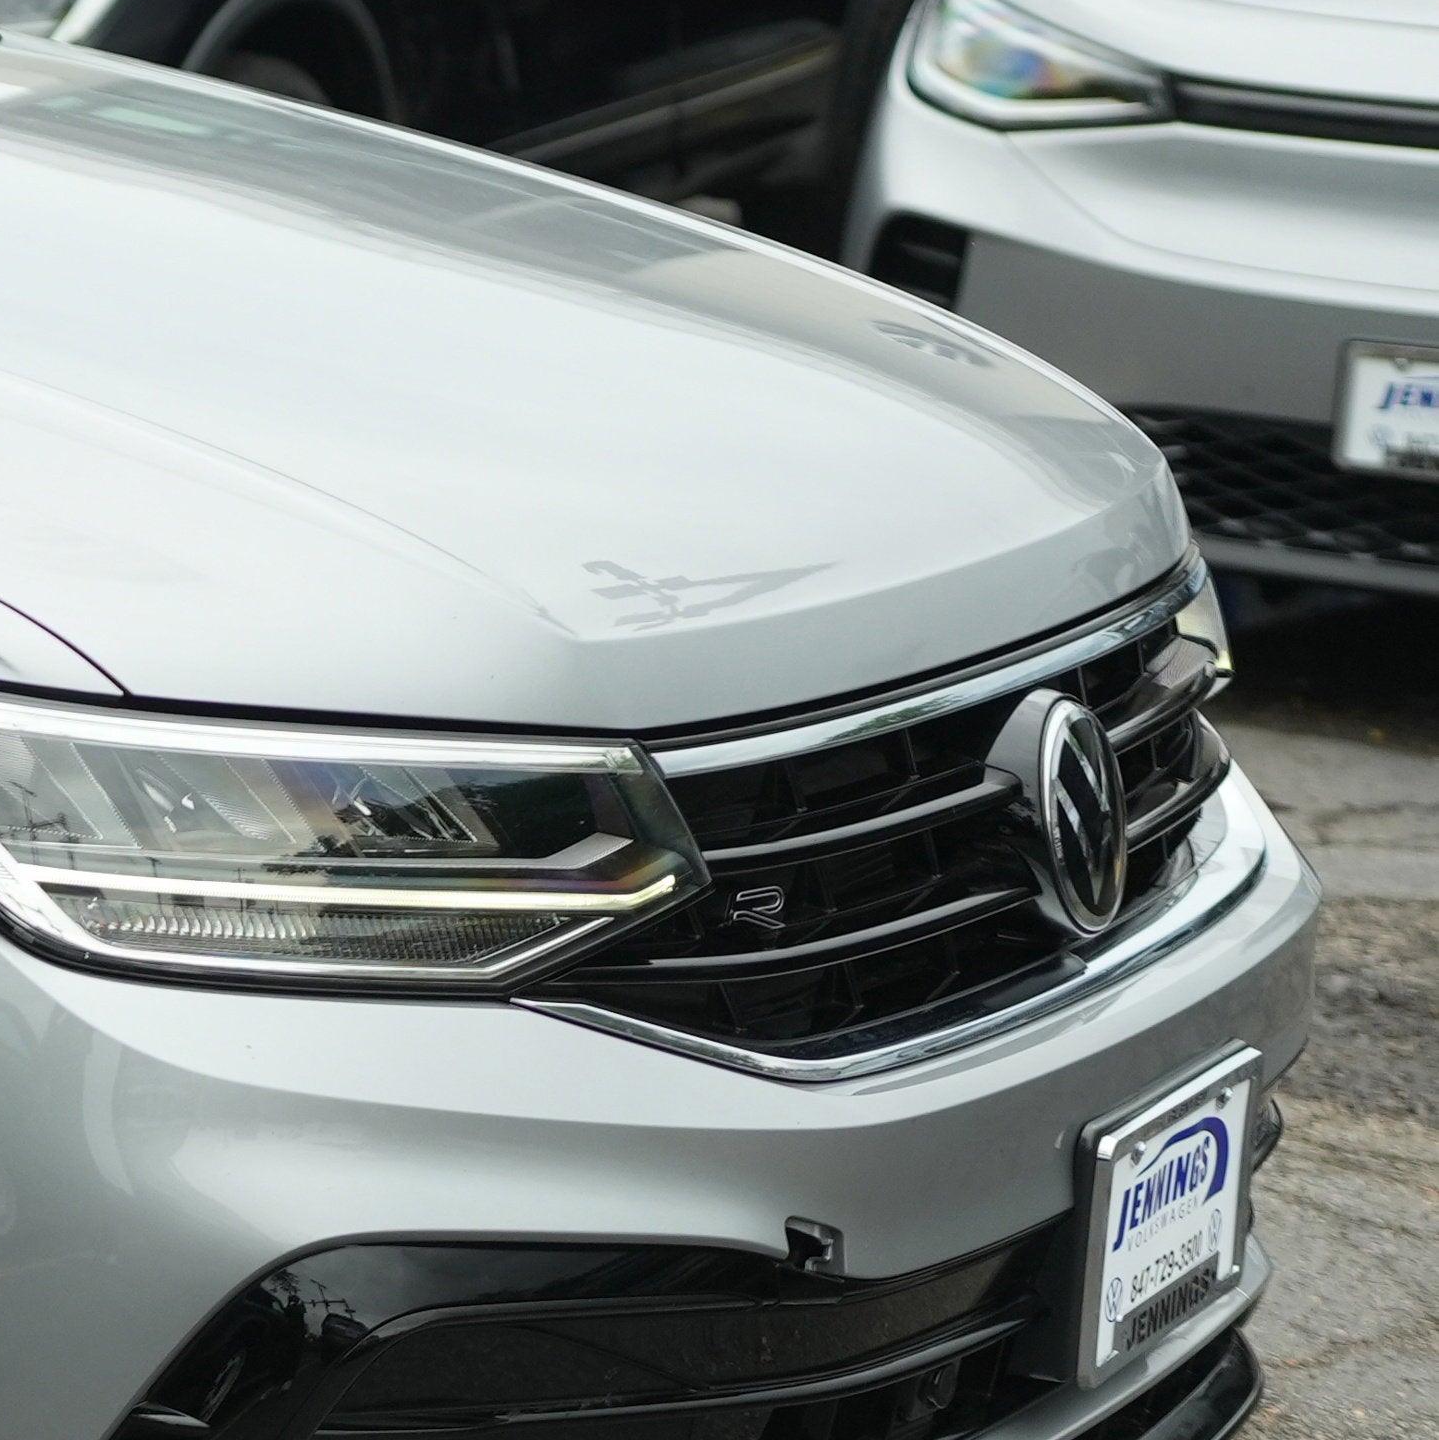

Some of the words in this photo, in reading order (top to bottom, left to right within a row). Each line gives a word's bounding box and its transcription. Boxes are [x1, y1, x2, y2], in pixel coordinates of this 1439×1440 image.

[1111, 1135, 1210, 1252] JENNINGS
[1126, 1195, 1199, 1251] VOLKSWAGEN
[1130, 1229, 1203, 1303] 847-729-3500
[1126, 1268, 1210, 1352] JENNINGS
